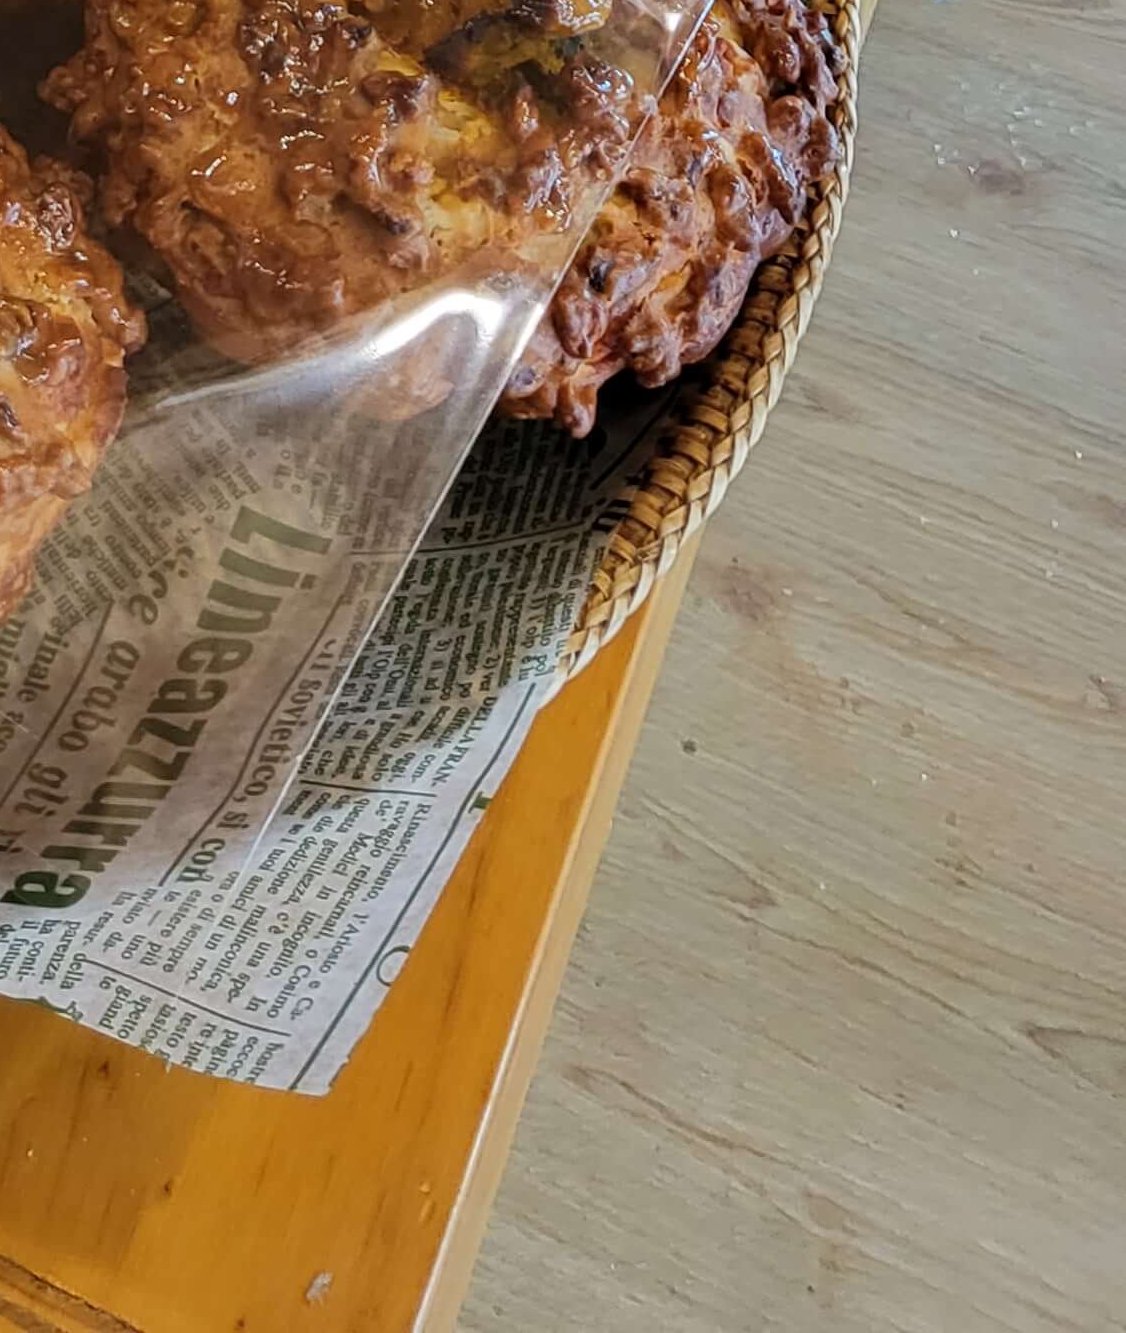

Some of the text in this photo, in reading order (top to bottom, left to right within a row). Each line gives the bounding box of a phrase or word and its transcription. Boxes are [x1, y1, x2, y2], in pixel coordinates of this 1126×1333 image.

[0, 505, 320, 911] Lineazzurra
[58, 642, 139, 751] arabo
[362, 804, 431, 902] Rinascimento,
